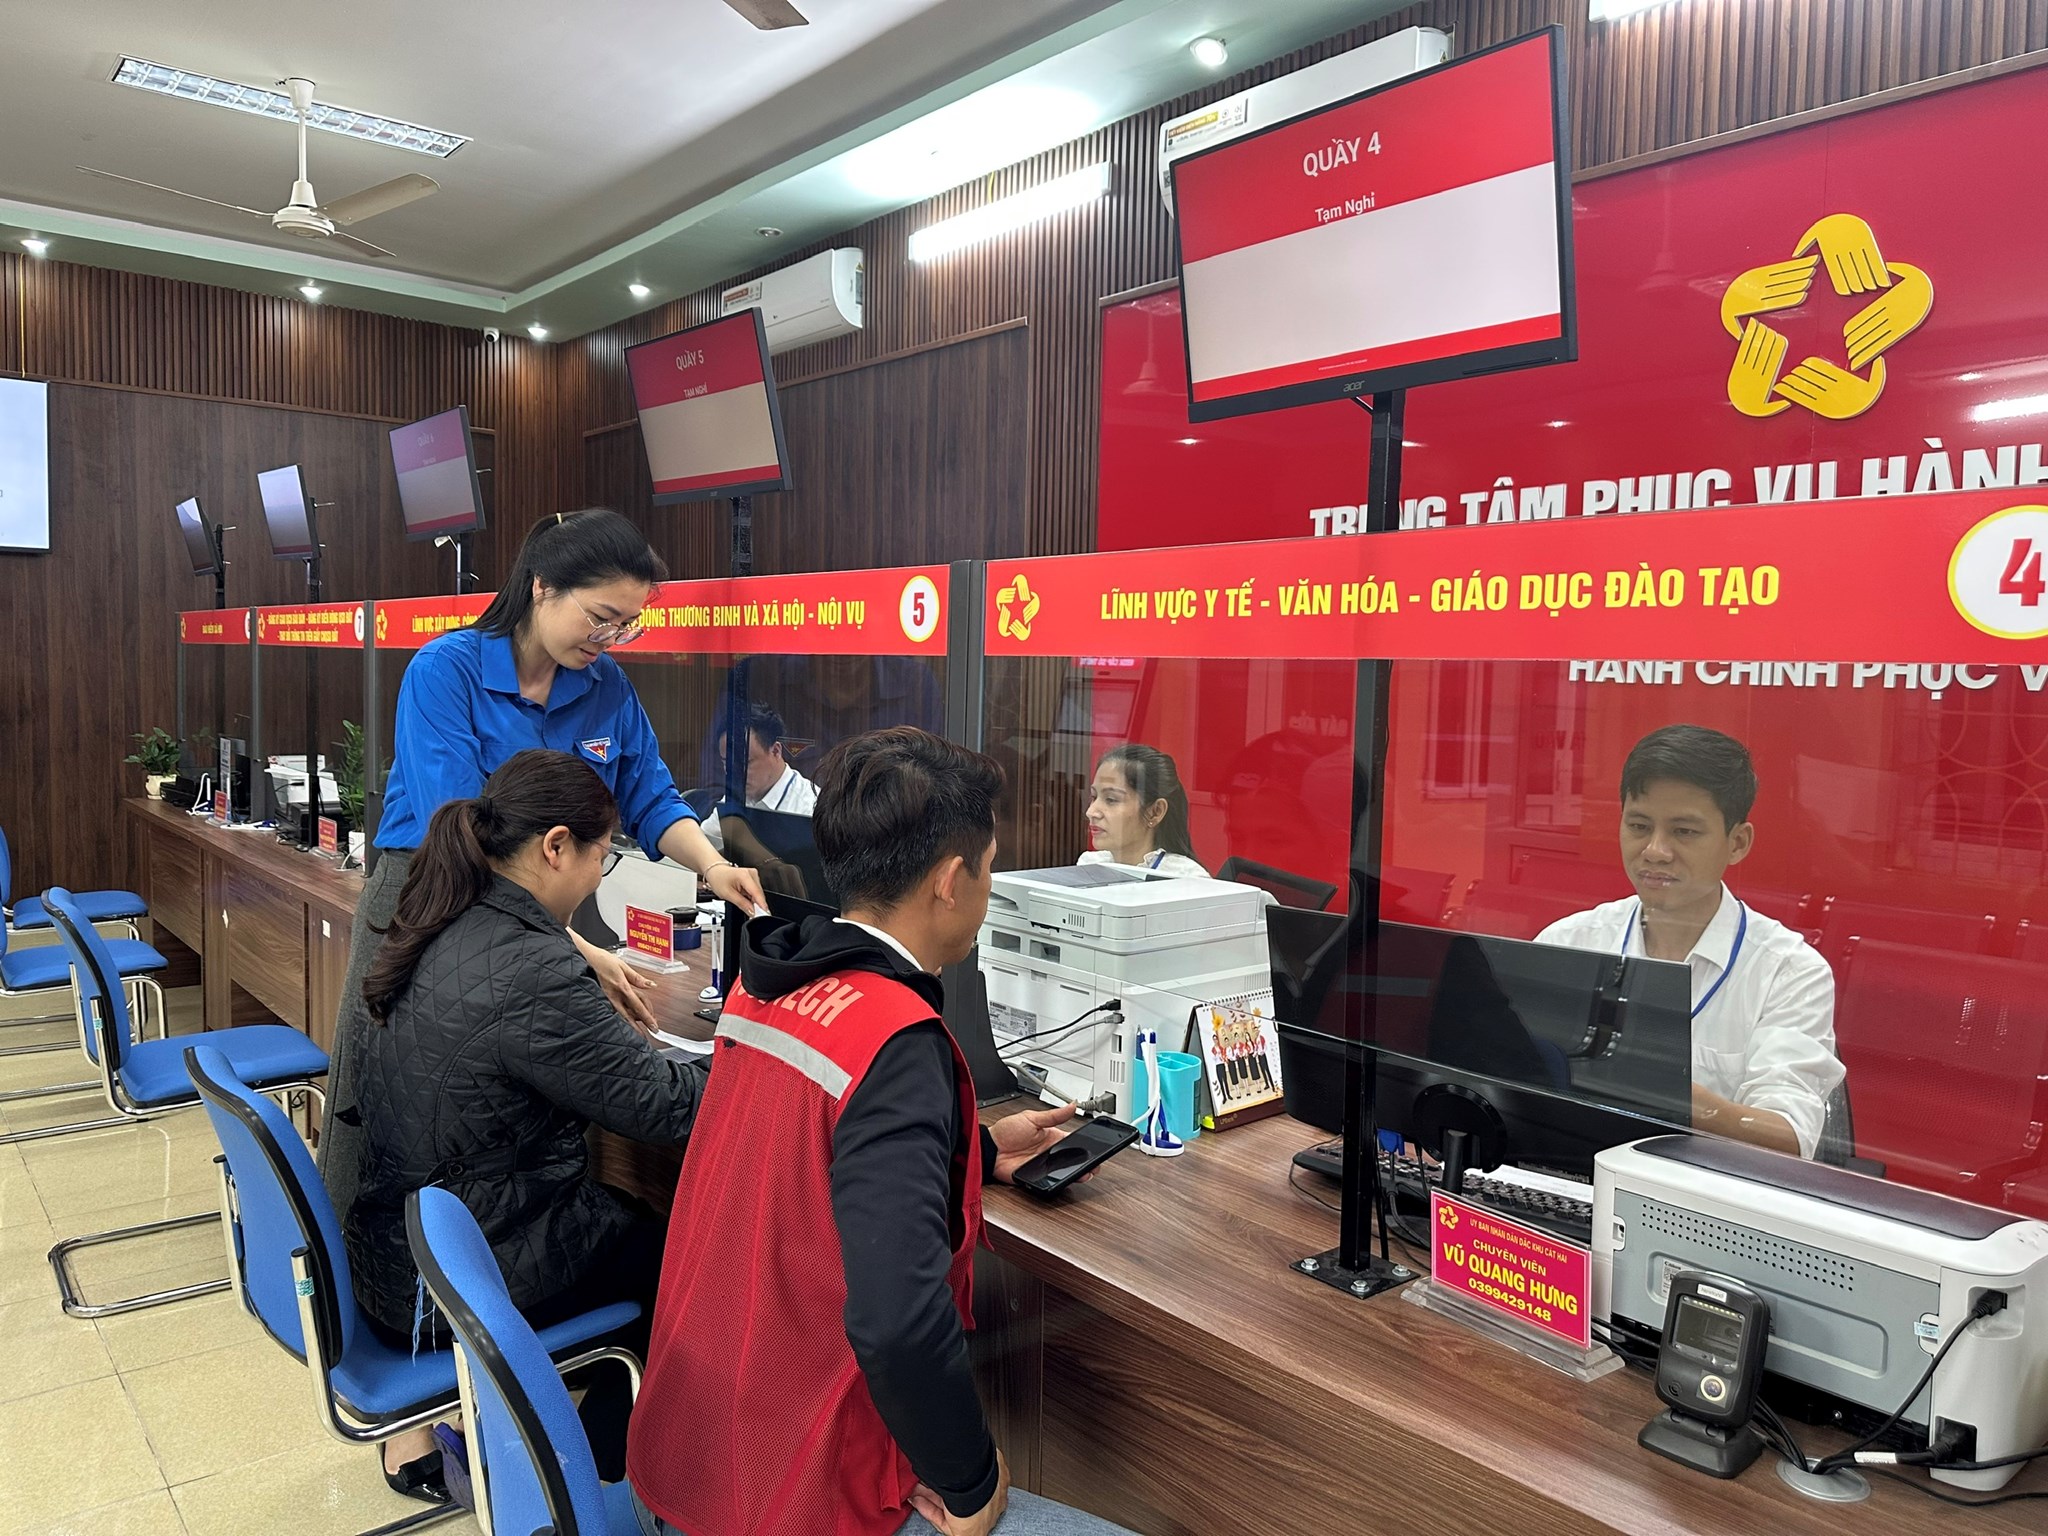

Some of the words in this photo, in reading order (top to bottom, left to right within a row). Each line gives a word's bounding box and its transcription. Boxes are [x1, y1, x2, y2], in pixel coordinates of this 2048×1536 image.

[1303, 137, 1361, 177] QUẦY
[1367, 131, 1381, 155] 4
[1315, 206, 1342, 223] Tạm
[676, 349, 697, 371] QUẦY
[698, 350, 704, 364] 5
[1343, 380, 1365, 392] acer
[1309, 496, 1446, 536] TRG
[1460, 476, 1567, 526] TÂM
[1999, 538, 2046, 606] 4
[912, 592, 926, 627] 5
[1101, 587, 1147, 620] LĨNH
[1154, 587, 1197, 625] VỰC
[1201, 589, 1219, 618] Y
[1225, 578, 1256, 617] TẾ
[1278, 578, 1331, 616] VĂN
[1341, 575, 1399, 615] HÓA
[1431, 569, 1509, 612] GIÁO
[1519, 572, 1593, 617] DỤC
[1604, 562, 1685, 608] ĐÀO
[1698, 565, 1780, 615] TẠO
[668, 606, 709, 627] THƯƠNG
[713, 604, 740, 627] BINH
[744, 600, 759, 626] VÀ
[762, 600, 779, 626] XÃ
[783, 598, 804, 631] HỘI
[818, 596, 842, 631] NỘI
[846, 600, 865, 630] VỤ
[1852, 663, 1999, 700] PHỤC
[1478, 1221, 1489, 1233] BAN
[1532, 1242, 1544, 1254] KHU
[1473, 1239, 1517, 1264] CHUYÊN
[1520, 1257, 1546, 1276] VIÊN
[1443, 1242, 1465, 1267] VŨ
[1468, 1254, 1525, 1293] QUANG
[1530, 1279, 1577, 1315] HƯNG
[1468, 1277, 1552, 1322] 0399429148
